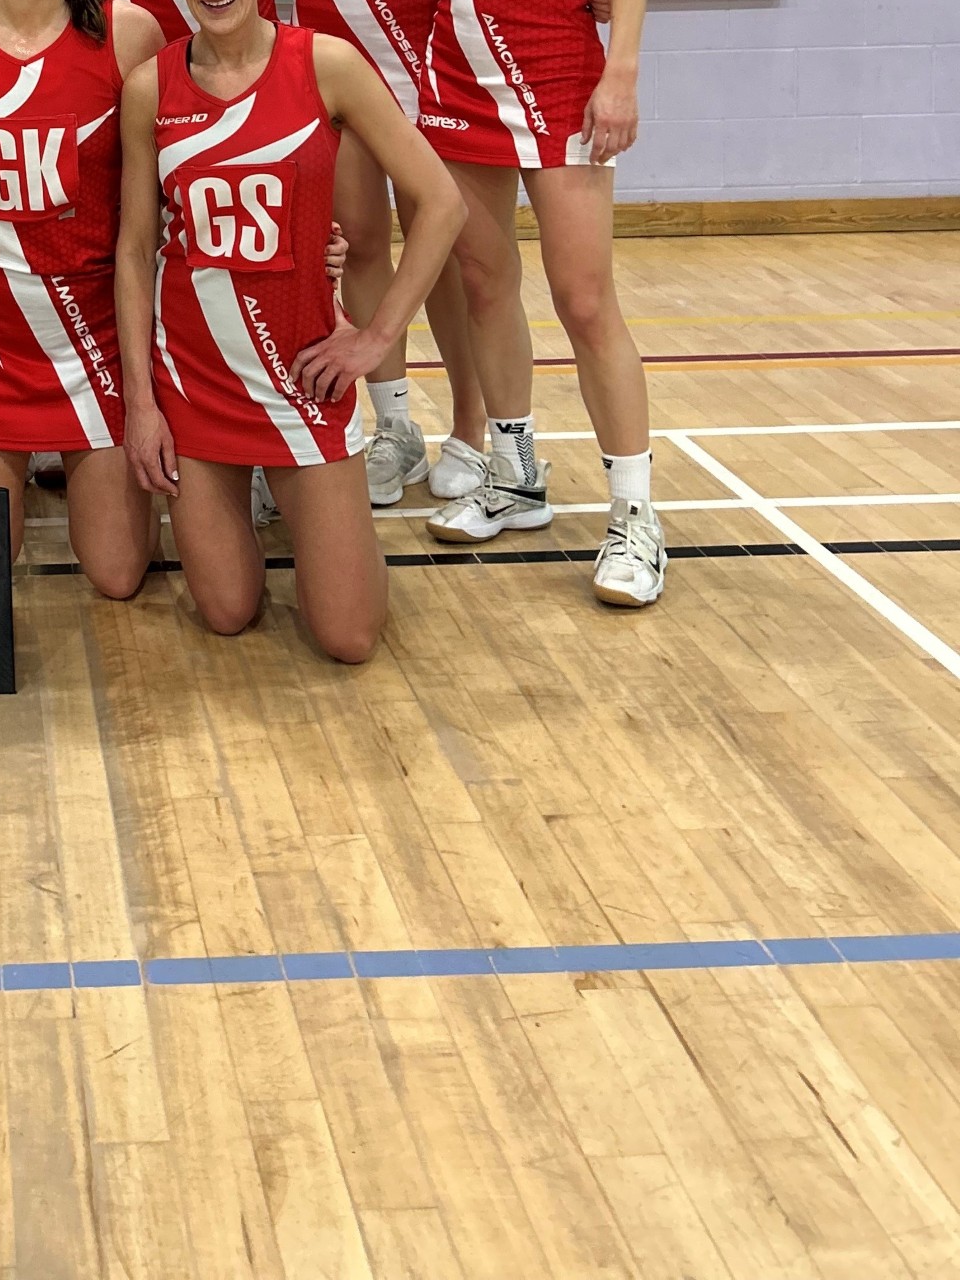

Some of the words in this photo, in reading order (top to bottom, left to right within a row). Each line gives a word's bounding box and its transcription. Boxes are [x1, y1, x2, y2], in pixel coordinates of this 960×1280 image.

[481, 13, 550, 136] ALMONDSBURY
[188, 173, 283, 262] GS
[51, 275, 119, 398] LMONDSBURY
